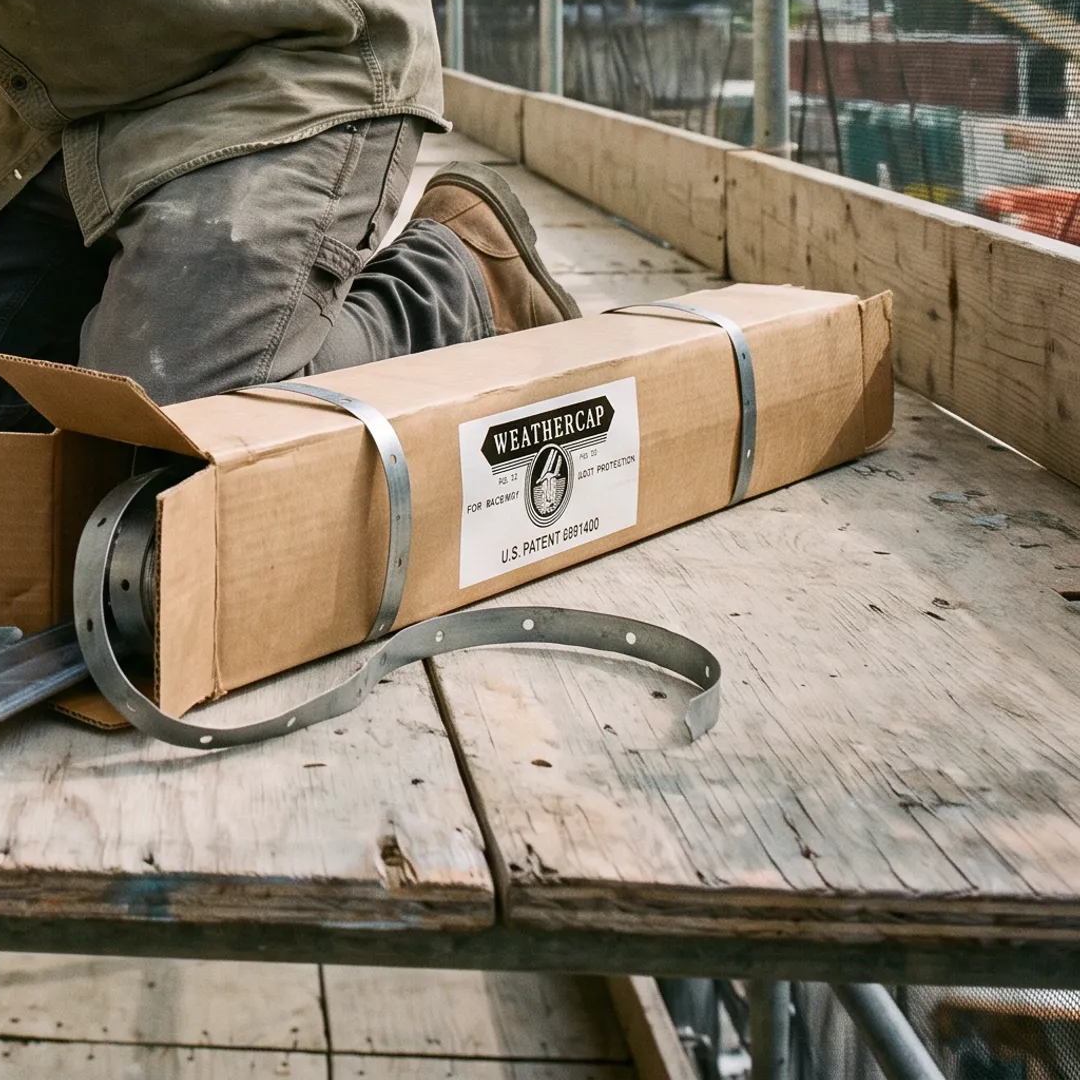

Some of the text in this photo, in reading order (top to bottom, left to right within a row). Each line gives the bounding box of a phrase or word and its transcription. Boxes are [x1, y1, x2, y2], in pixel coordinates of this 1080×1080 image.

[493, 405, 605, 455] WEATHERCAP
[467, 501, 482, 514] FOR
[501, 545, 521, 564] U.S.
[523, 530, 561, 557] PATENT
